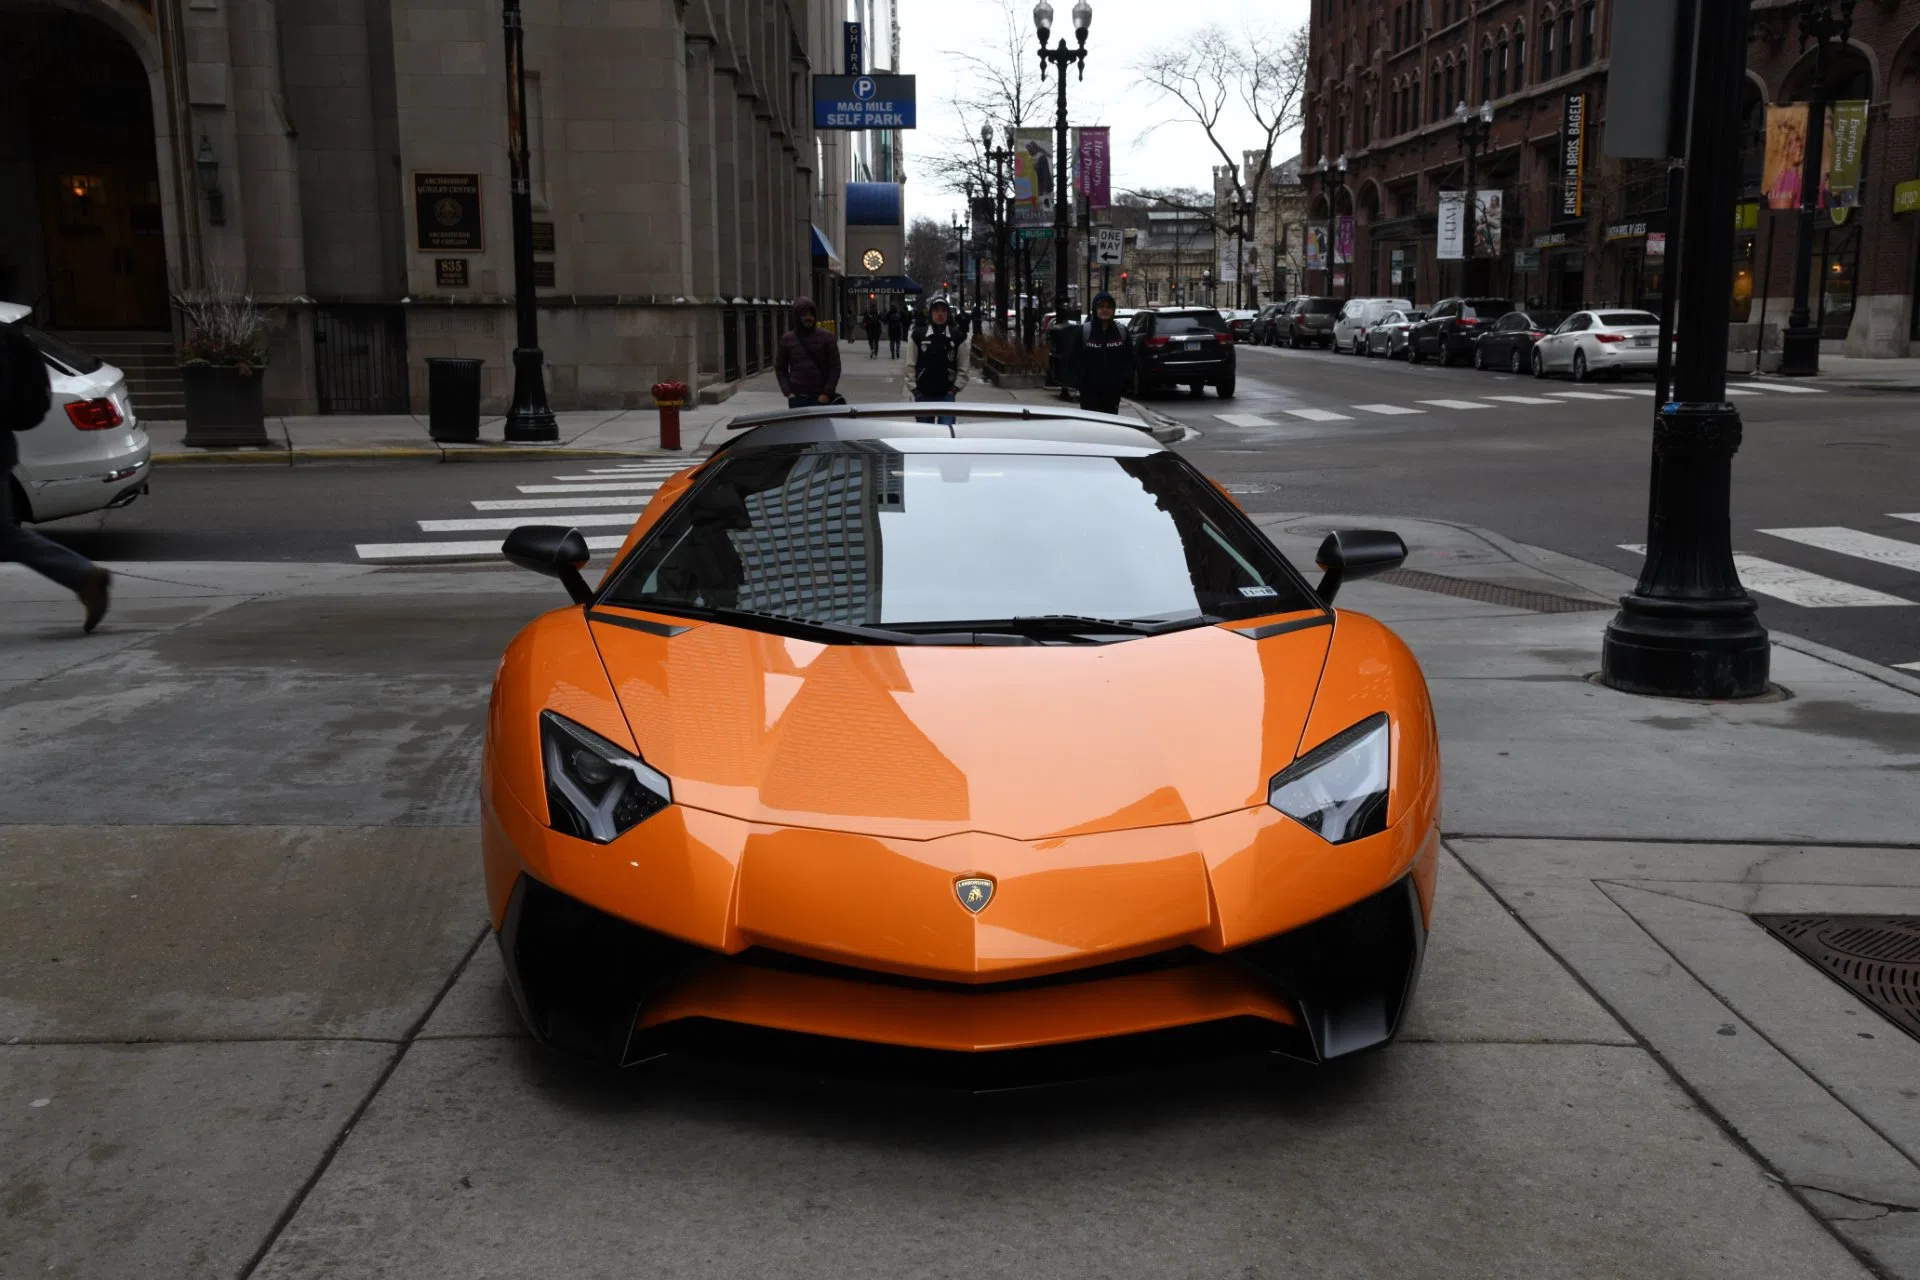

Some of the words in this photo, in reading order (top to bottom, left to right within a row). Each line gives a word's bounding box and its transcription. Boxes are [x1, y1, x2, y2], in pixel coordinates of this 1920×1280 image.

[859, 80, 871, 97] P
[837, 102, 862, 112] MAG
[866, 102, 893, 112] MILE
[827, 113, 862, 125] SELF
[865, 113, 903, 125] PARK
[1568, 96, 1581, 135] BAGELS
[1081, 140, 1092, 155] My
[1094, 140, 1103, 158] Her
[1834, 119, 1848, 172] Englewood
[1845, 118, 1860, 164] Everyday
[1564, 168, 1577, 215] EINSTEIN
[1101, 231, 1120, 240] ONE
[1100, 242, 1120, 250] WAY
[441, 261, 462, 272] 835
